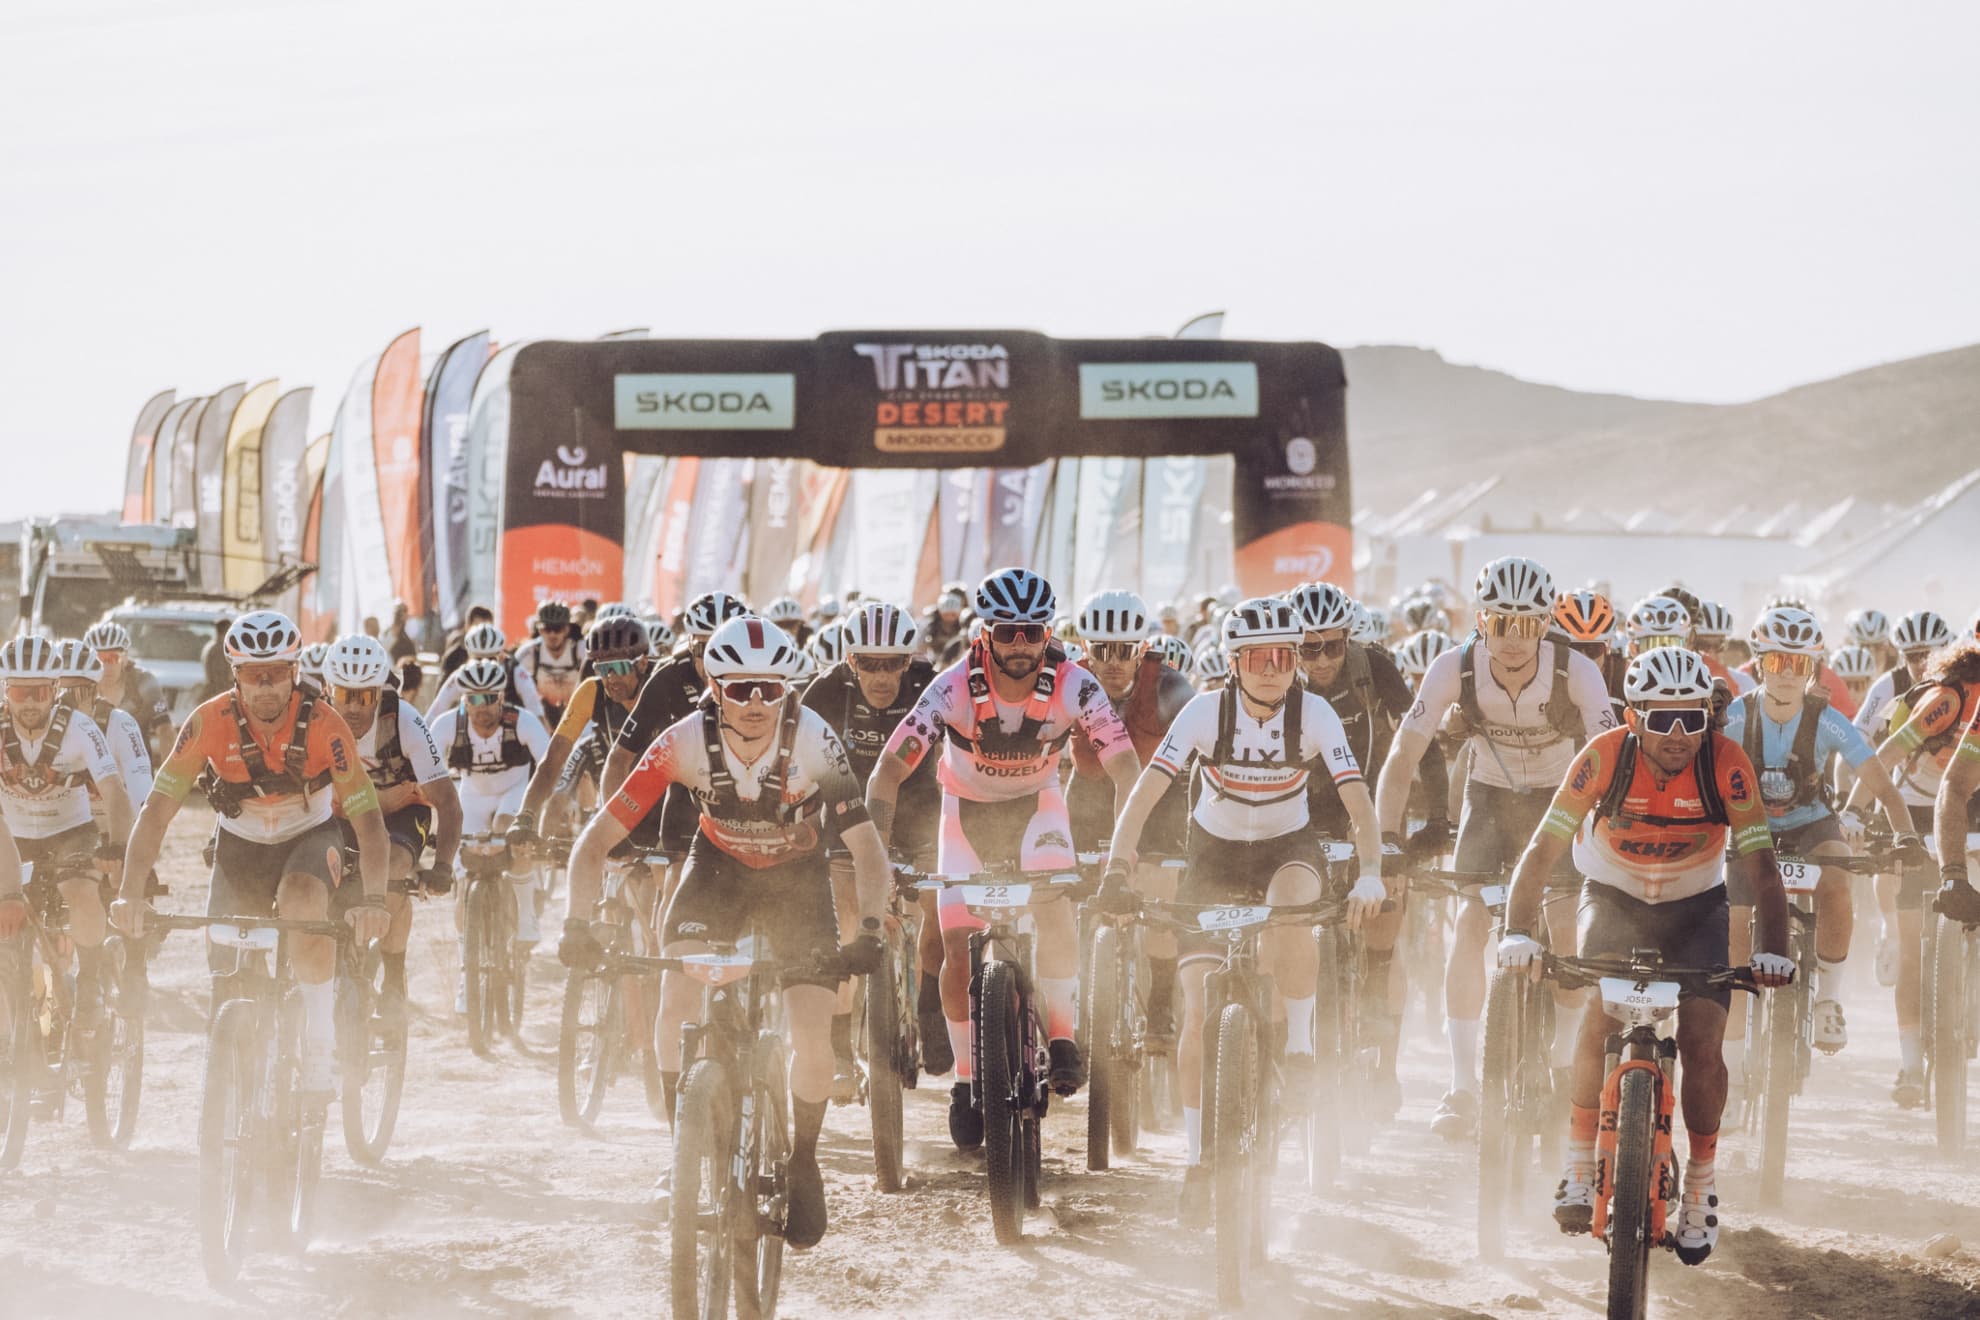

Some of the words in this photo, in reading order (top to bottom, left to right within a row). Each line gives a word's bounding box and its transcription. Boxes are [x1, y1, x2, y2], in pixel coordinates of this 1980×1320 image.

[916, 344, 1008, 359] SKODA
[854, 343, 1009, 390] TITAN
[1101, 379, 1236, 401] SKODA
[636, 392, 772, 413] SKODA
[876, 402, 1009, 425] DESERT
[886, 433, 992, 446] MOROCCO
[534, 460, 608, 489] Aural
[533, 556, 604, 575] HEMÓN
[413, 716, 441, 766] SKODA
[1618, 839, 1692, 859] KH7
[985, 886, 1008, 898] 22
[1215, 907, 1254, 922] 202
[1624, 995, 1653, 1005] JOSEP
